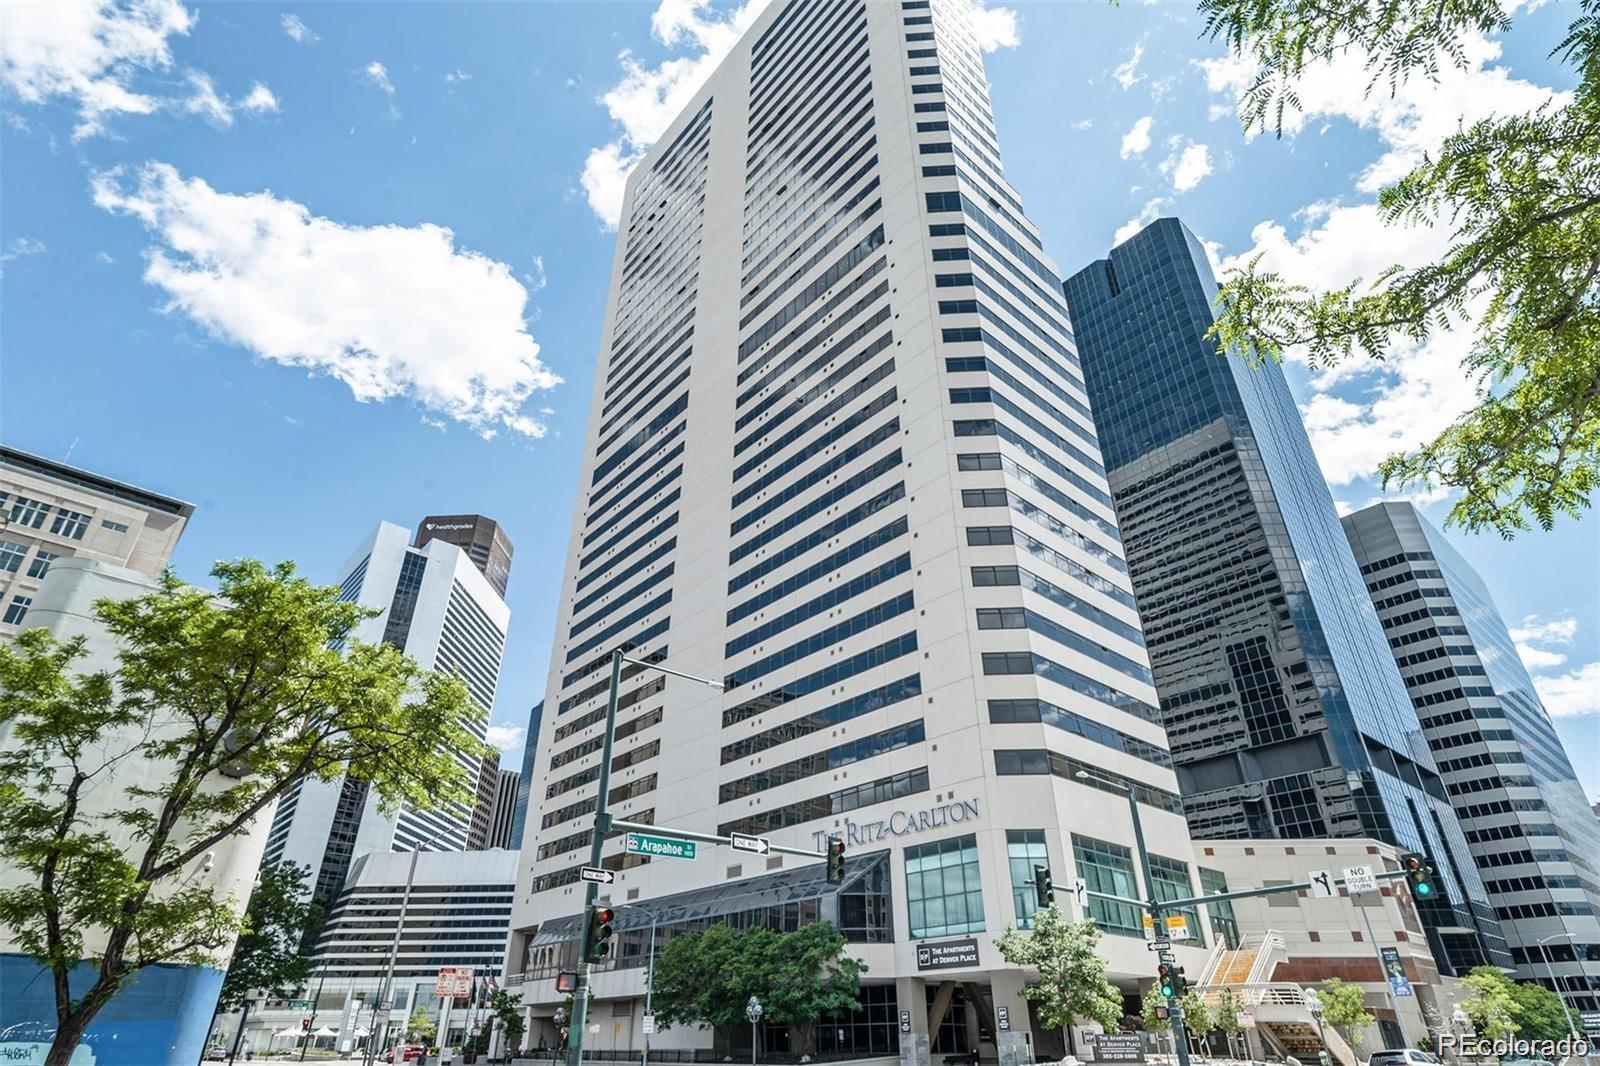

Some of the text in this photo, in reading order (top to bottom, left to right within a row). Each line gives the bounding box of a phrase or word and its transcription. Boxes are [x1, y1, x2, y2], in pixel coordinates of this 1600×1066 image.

[847, 798, 980, 847] RITZ-CARLTON
[641, 838, 683, 855] Arapahoe
[735, 838, 758, 848] ONE WAY
[1350, 867, 1365, 876] NO
[1346, 875, 1373, 885] DOUBLE
[931, 945, 975, 955] THE APARTMENTS
[939, 956, 959, 964] DENVER
[960, 954, 977, 962] PLACE
